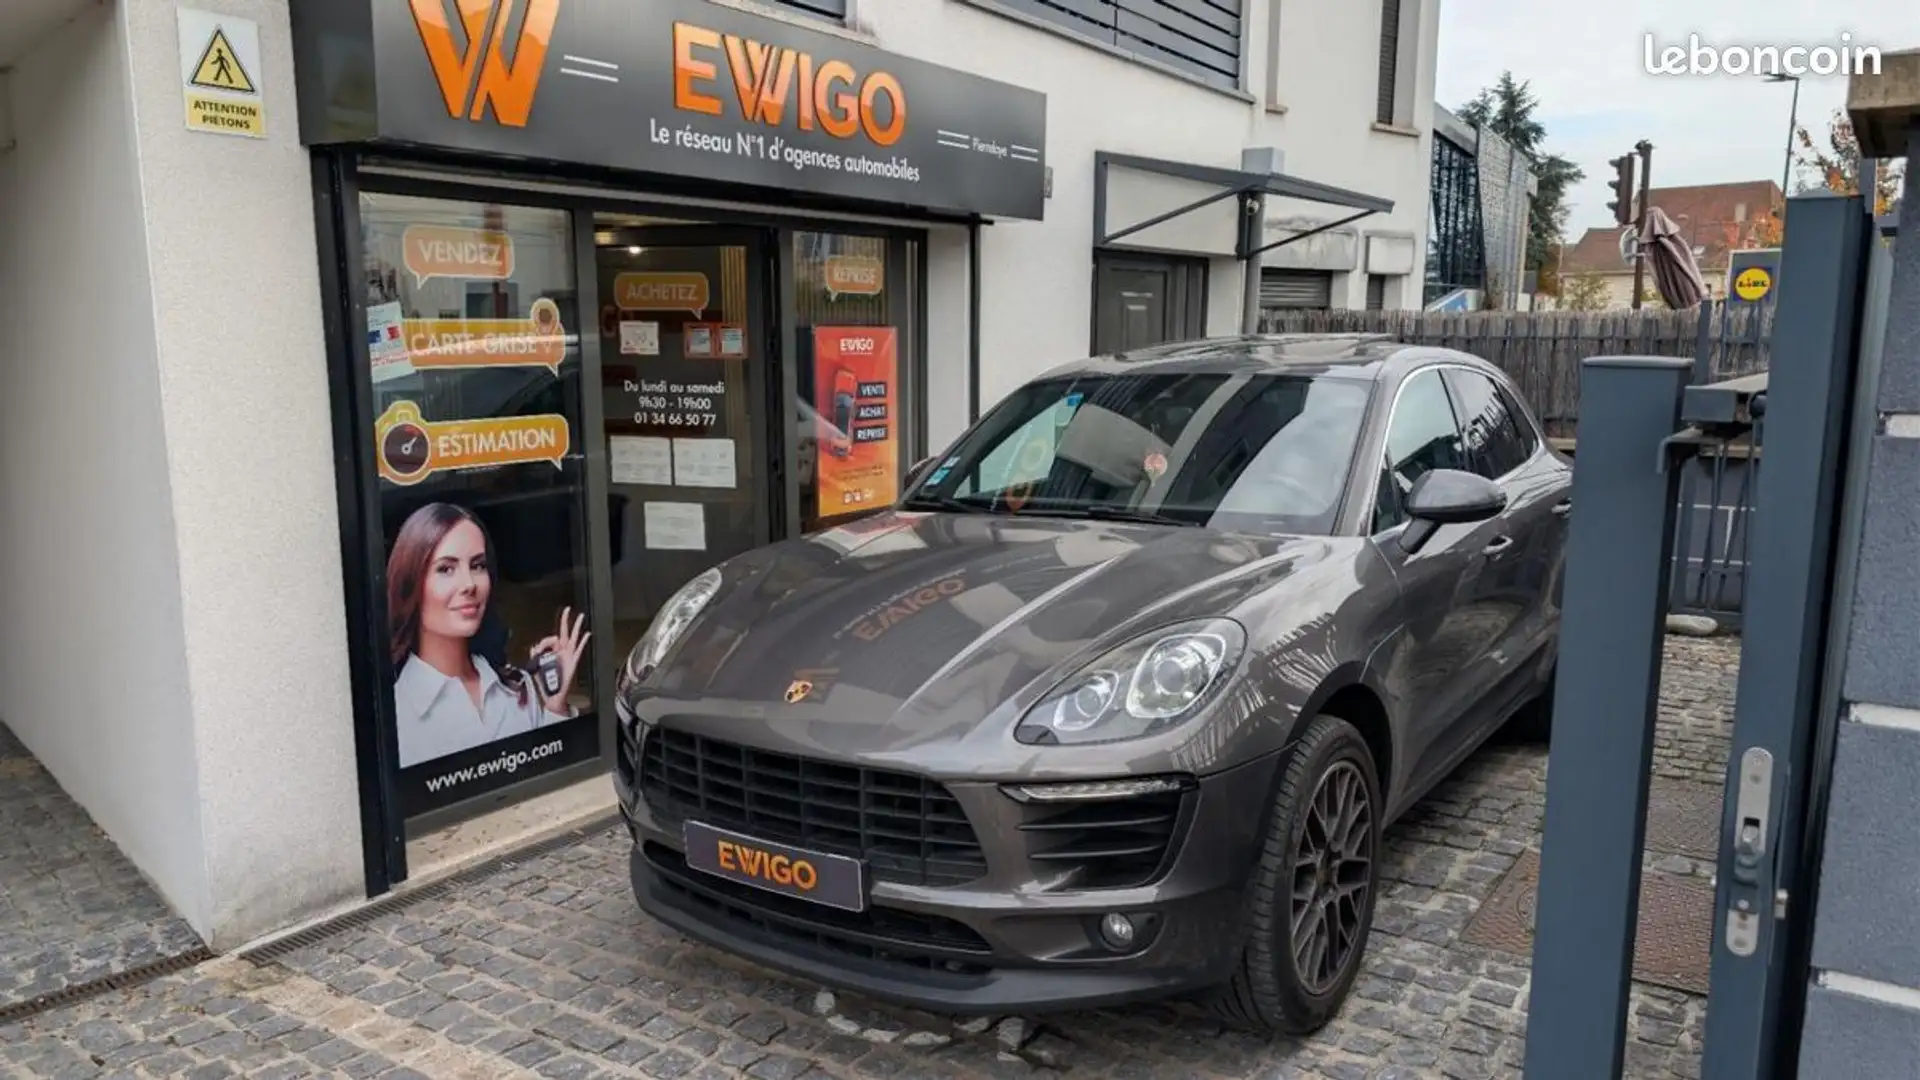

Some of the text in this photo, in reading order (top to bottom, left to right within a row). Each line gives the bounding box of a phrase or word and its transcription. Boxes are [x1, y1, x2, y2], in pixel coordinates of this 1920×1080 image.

[673, 20, 907, 147] EWIGO
[194, 100, 258, 117] ATTENTION
[650, 117, 670, 144] Le
[675, 123, 731, 154] réseau
[769, 136, 841, 170] d'agences
[845, 155, 920, 181] automobiles
[418, 238, 503, 266] VENDEZ
[626, 282, 698, 300] ACHETEZ
[411, 332, 475, 355] CARTE
[840, 337, 875, 351] EWIGO
[624, 379, 725, 394] Du lundi au samedi
[860, 384, 886, 396] VENTE
[639, 396, 666, 409] 9h30
[678, 397, 712, 410] 19h00
[860, 406, 886, 418] ACHAT
[634, 412, 717, 426] 01 34 66 50 77
[438, 427, 556, 458] ESTIMATION
[425, 738, 564, 793] www.ewigo.com
[718, 840, 817, 890] EWIGO
